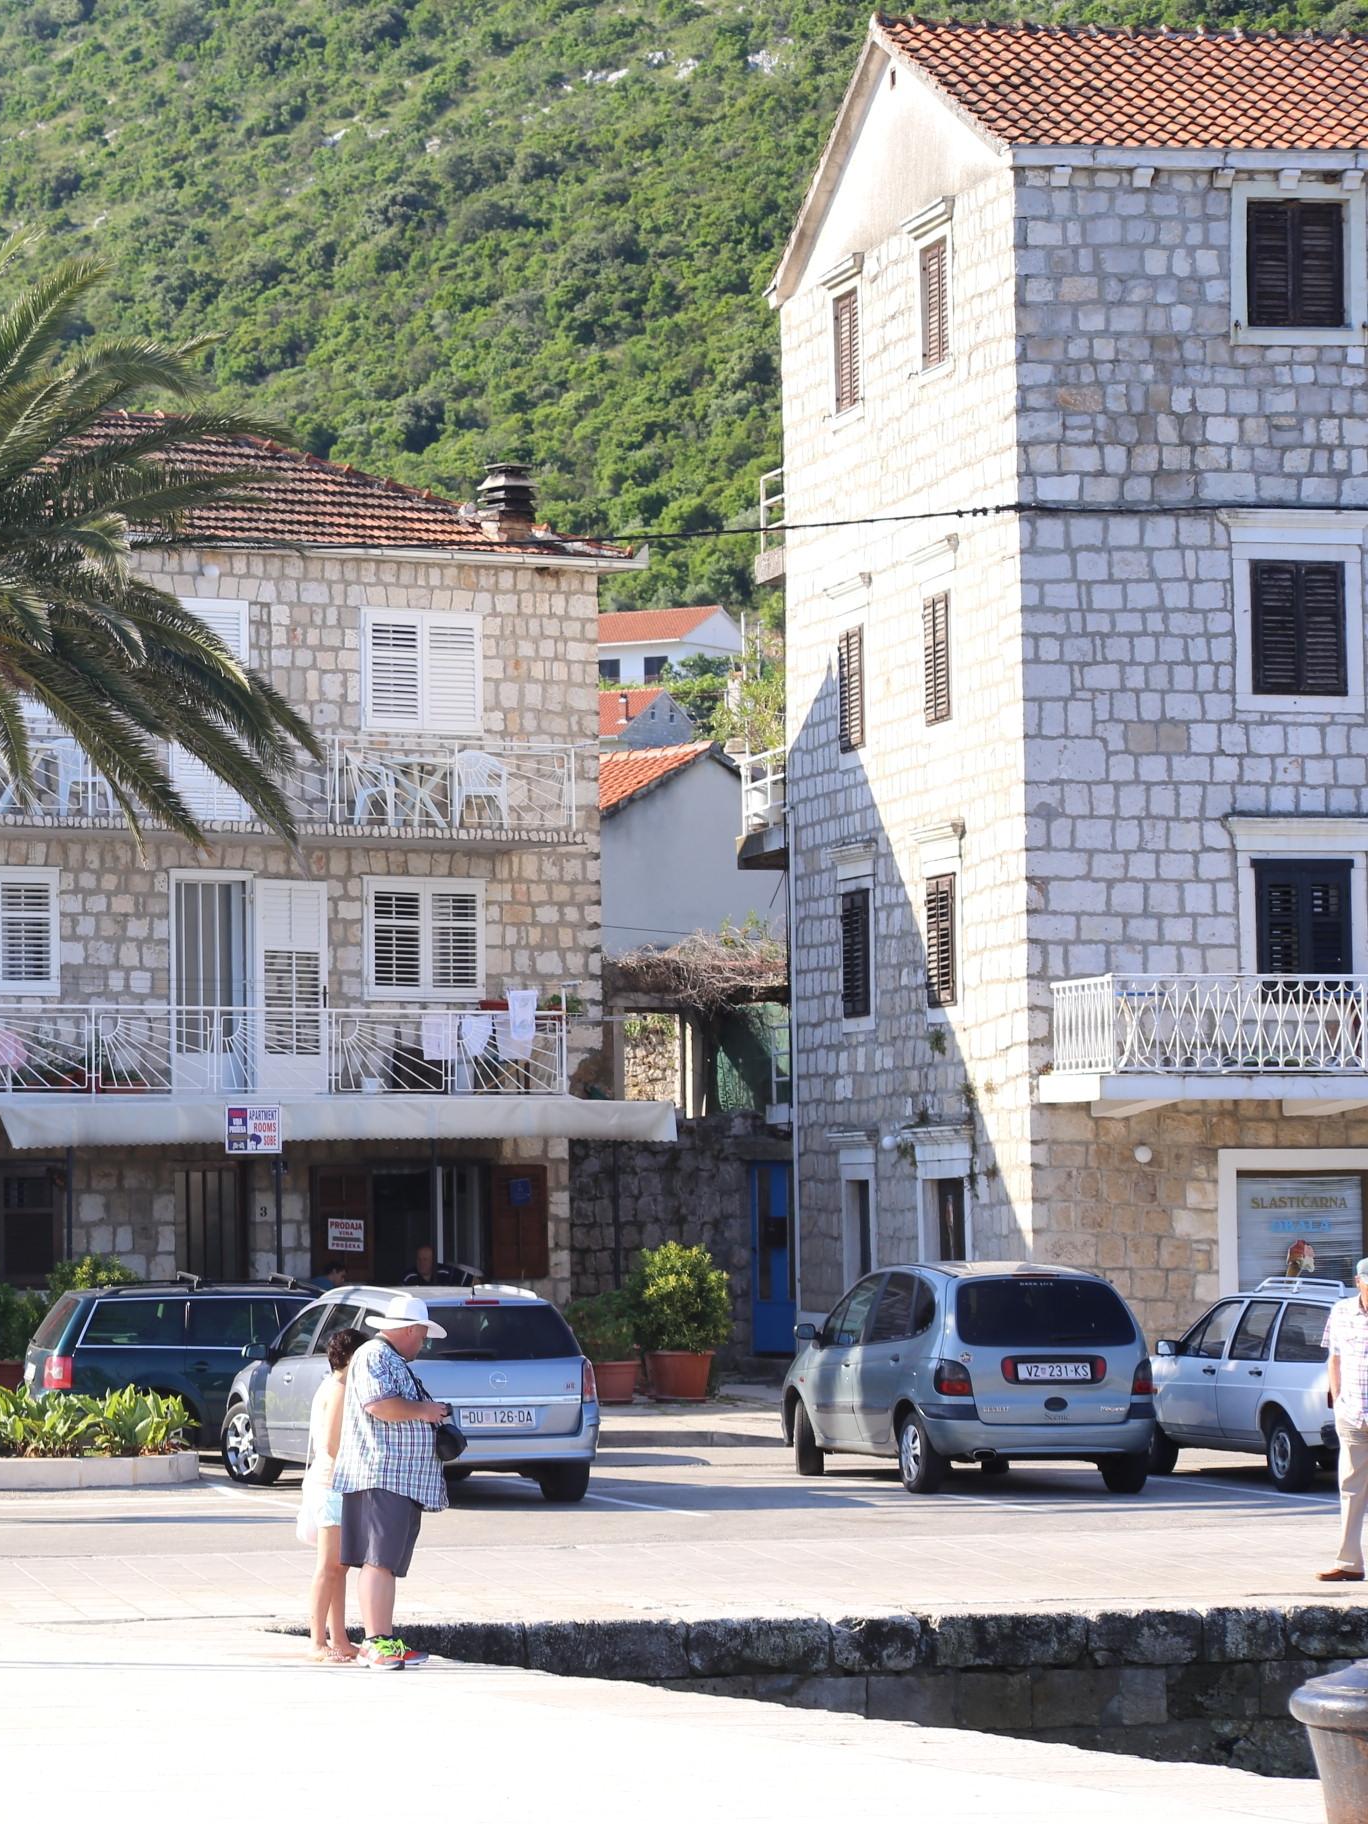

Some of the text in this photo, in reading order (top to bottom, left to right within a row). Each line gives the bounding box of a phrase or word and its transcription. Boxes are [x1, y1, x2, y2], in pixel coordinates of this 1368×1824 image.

[249, 1110, 277, 1120] APARTMENT
[254, 1122, 277, 1133] ROOMS
[263, 1135, 277, 1146] SOBE
[260, 1206, 268, 1217] 3
[329, 1221, 362, 1230] PRODAJA
[1026, 1365, 1089, 1377] VZ 231-KS
[469, 1410, 532, 1423] DU 126-DA
